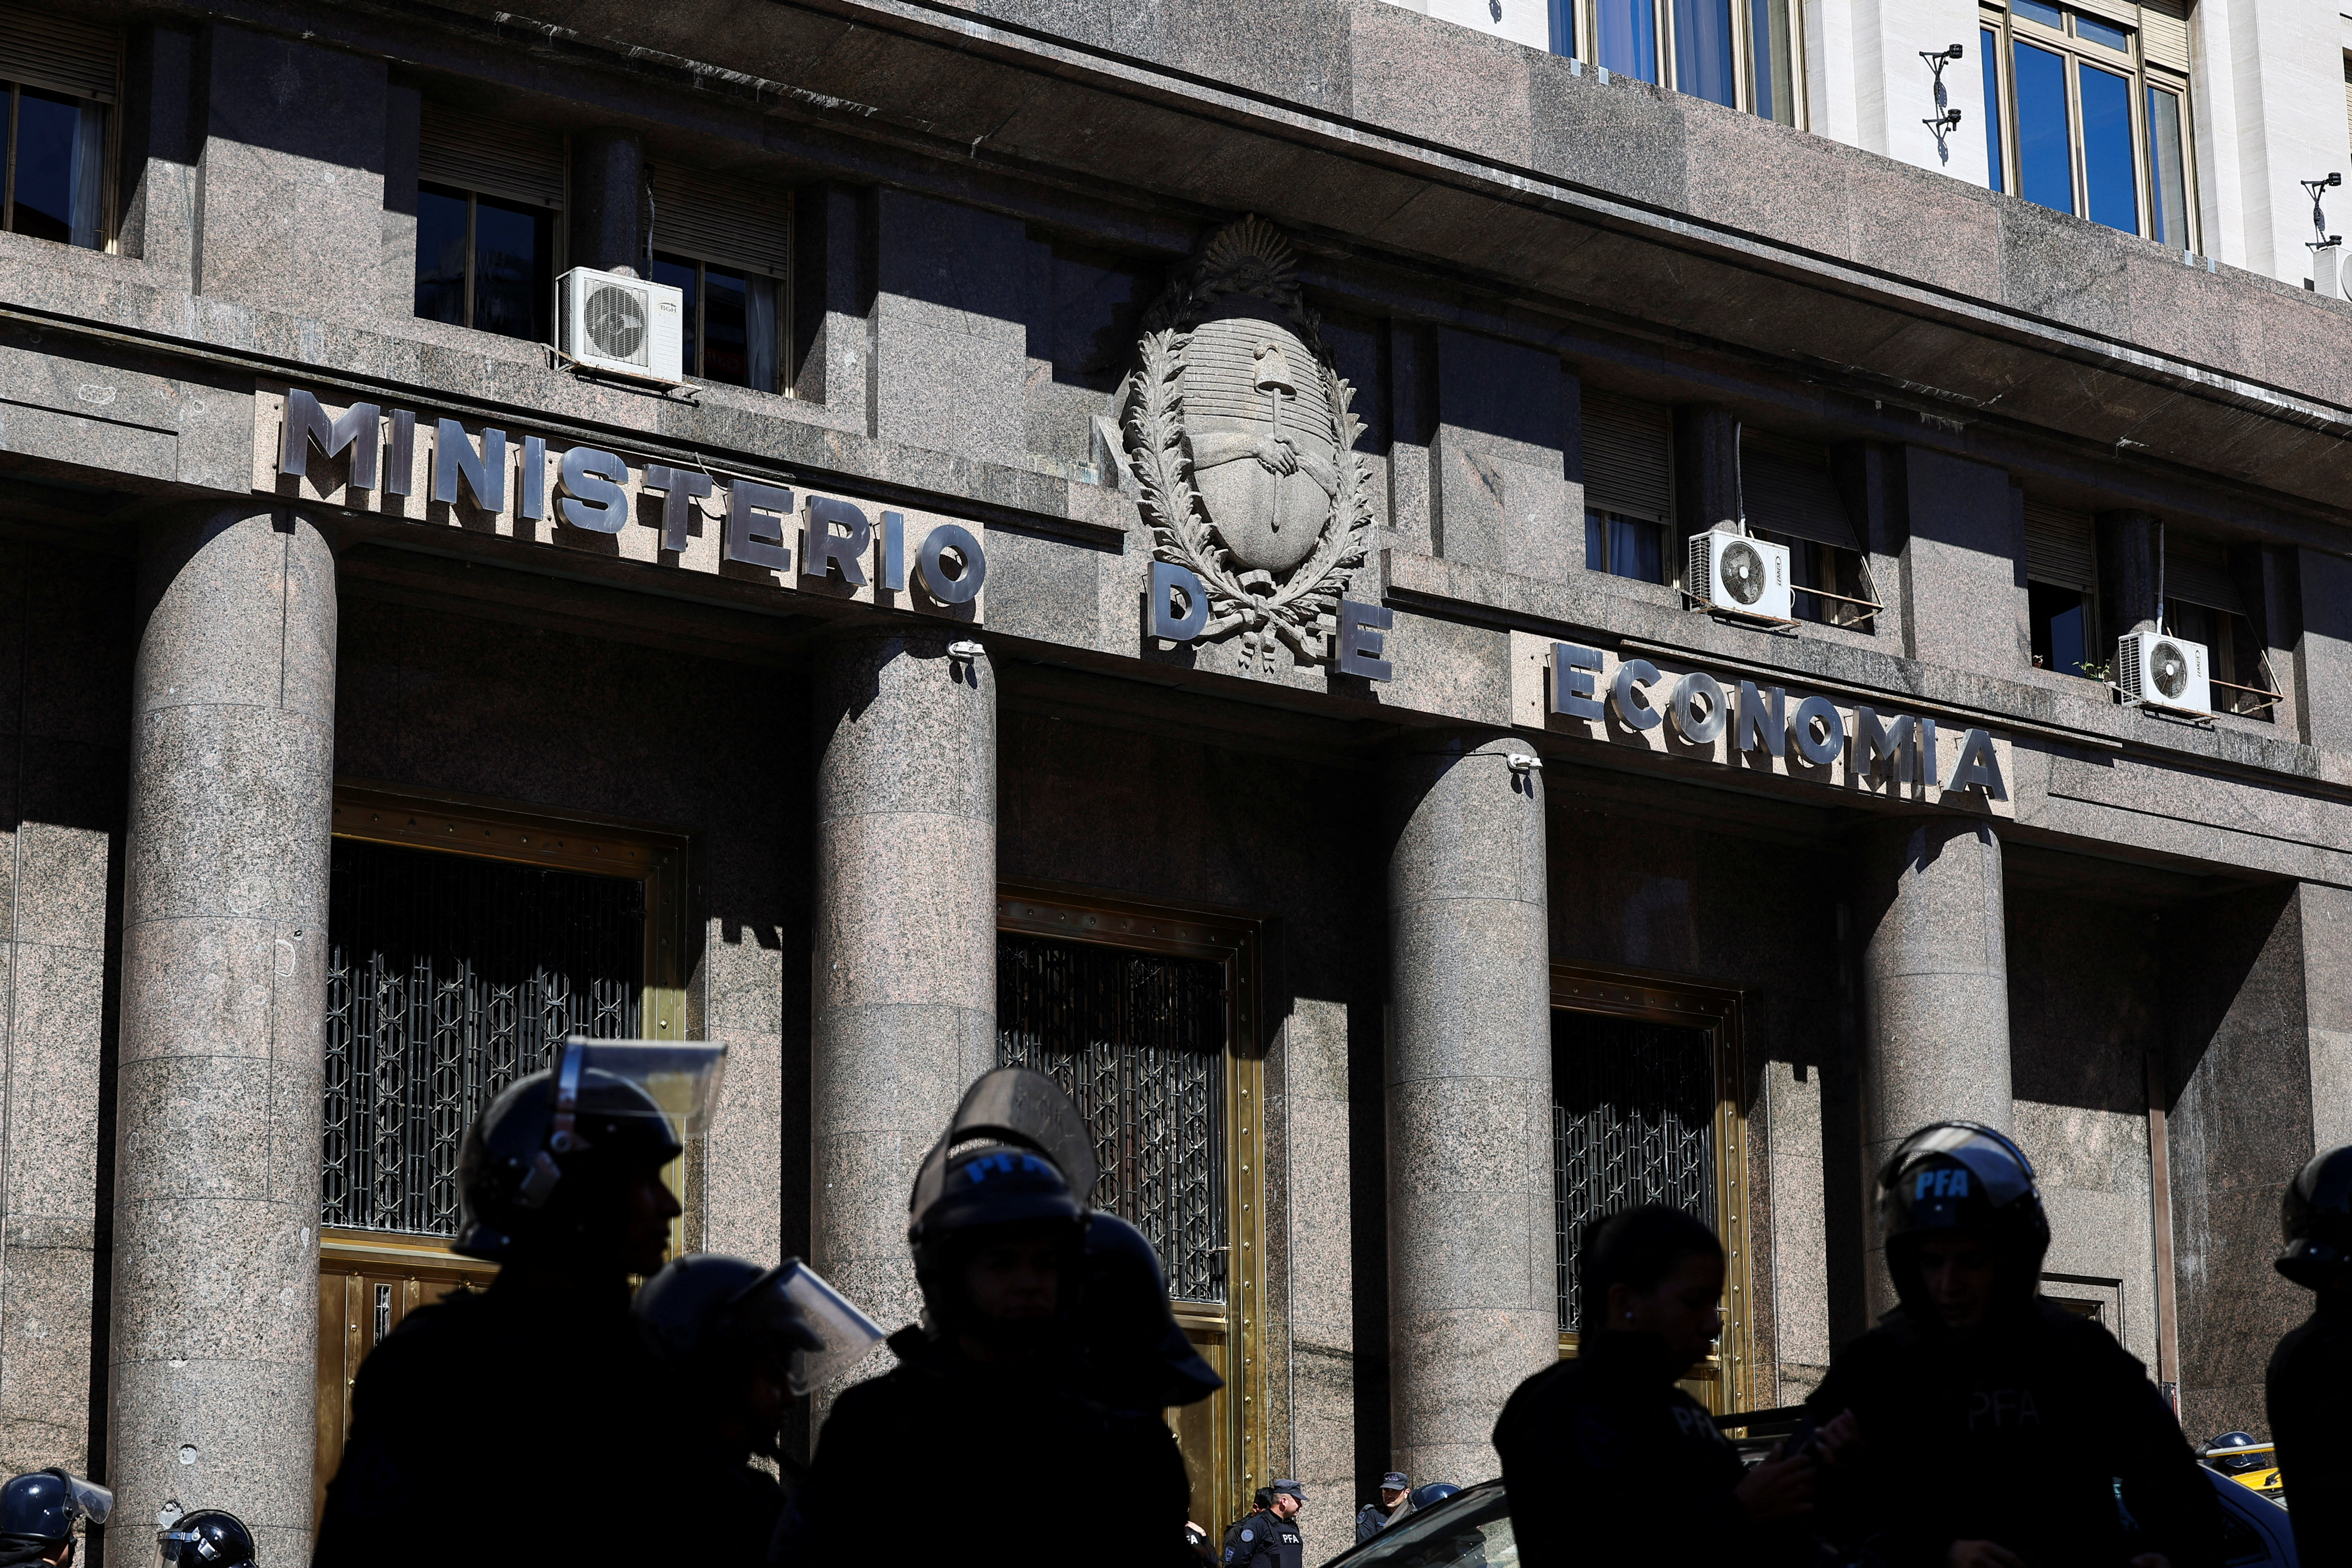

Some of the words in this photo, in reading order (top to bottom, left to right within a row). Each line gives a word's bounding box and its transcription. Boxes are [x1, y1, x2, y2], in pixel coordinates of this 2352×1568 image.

[661, 305, 677, 313] BGH
[279, 388, 986, 605] MINISTERIO
[1550, 641, 2009, 802] ECONOMIA
[1915, 1169, 1969, 1201] PFA
[1968, 1388, 2041, 1432] PFA
[1282, 1534, 1300, 1544] PFA
